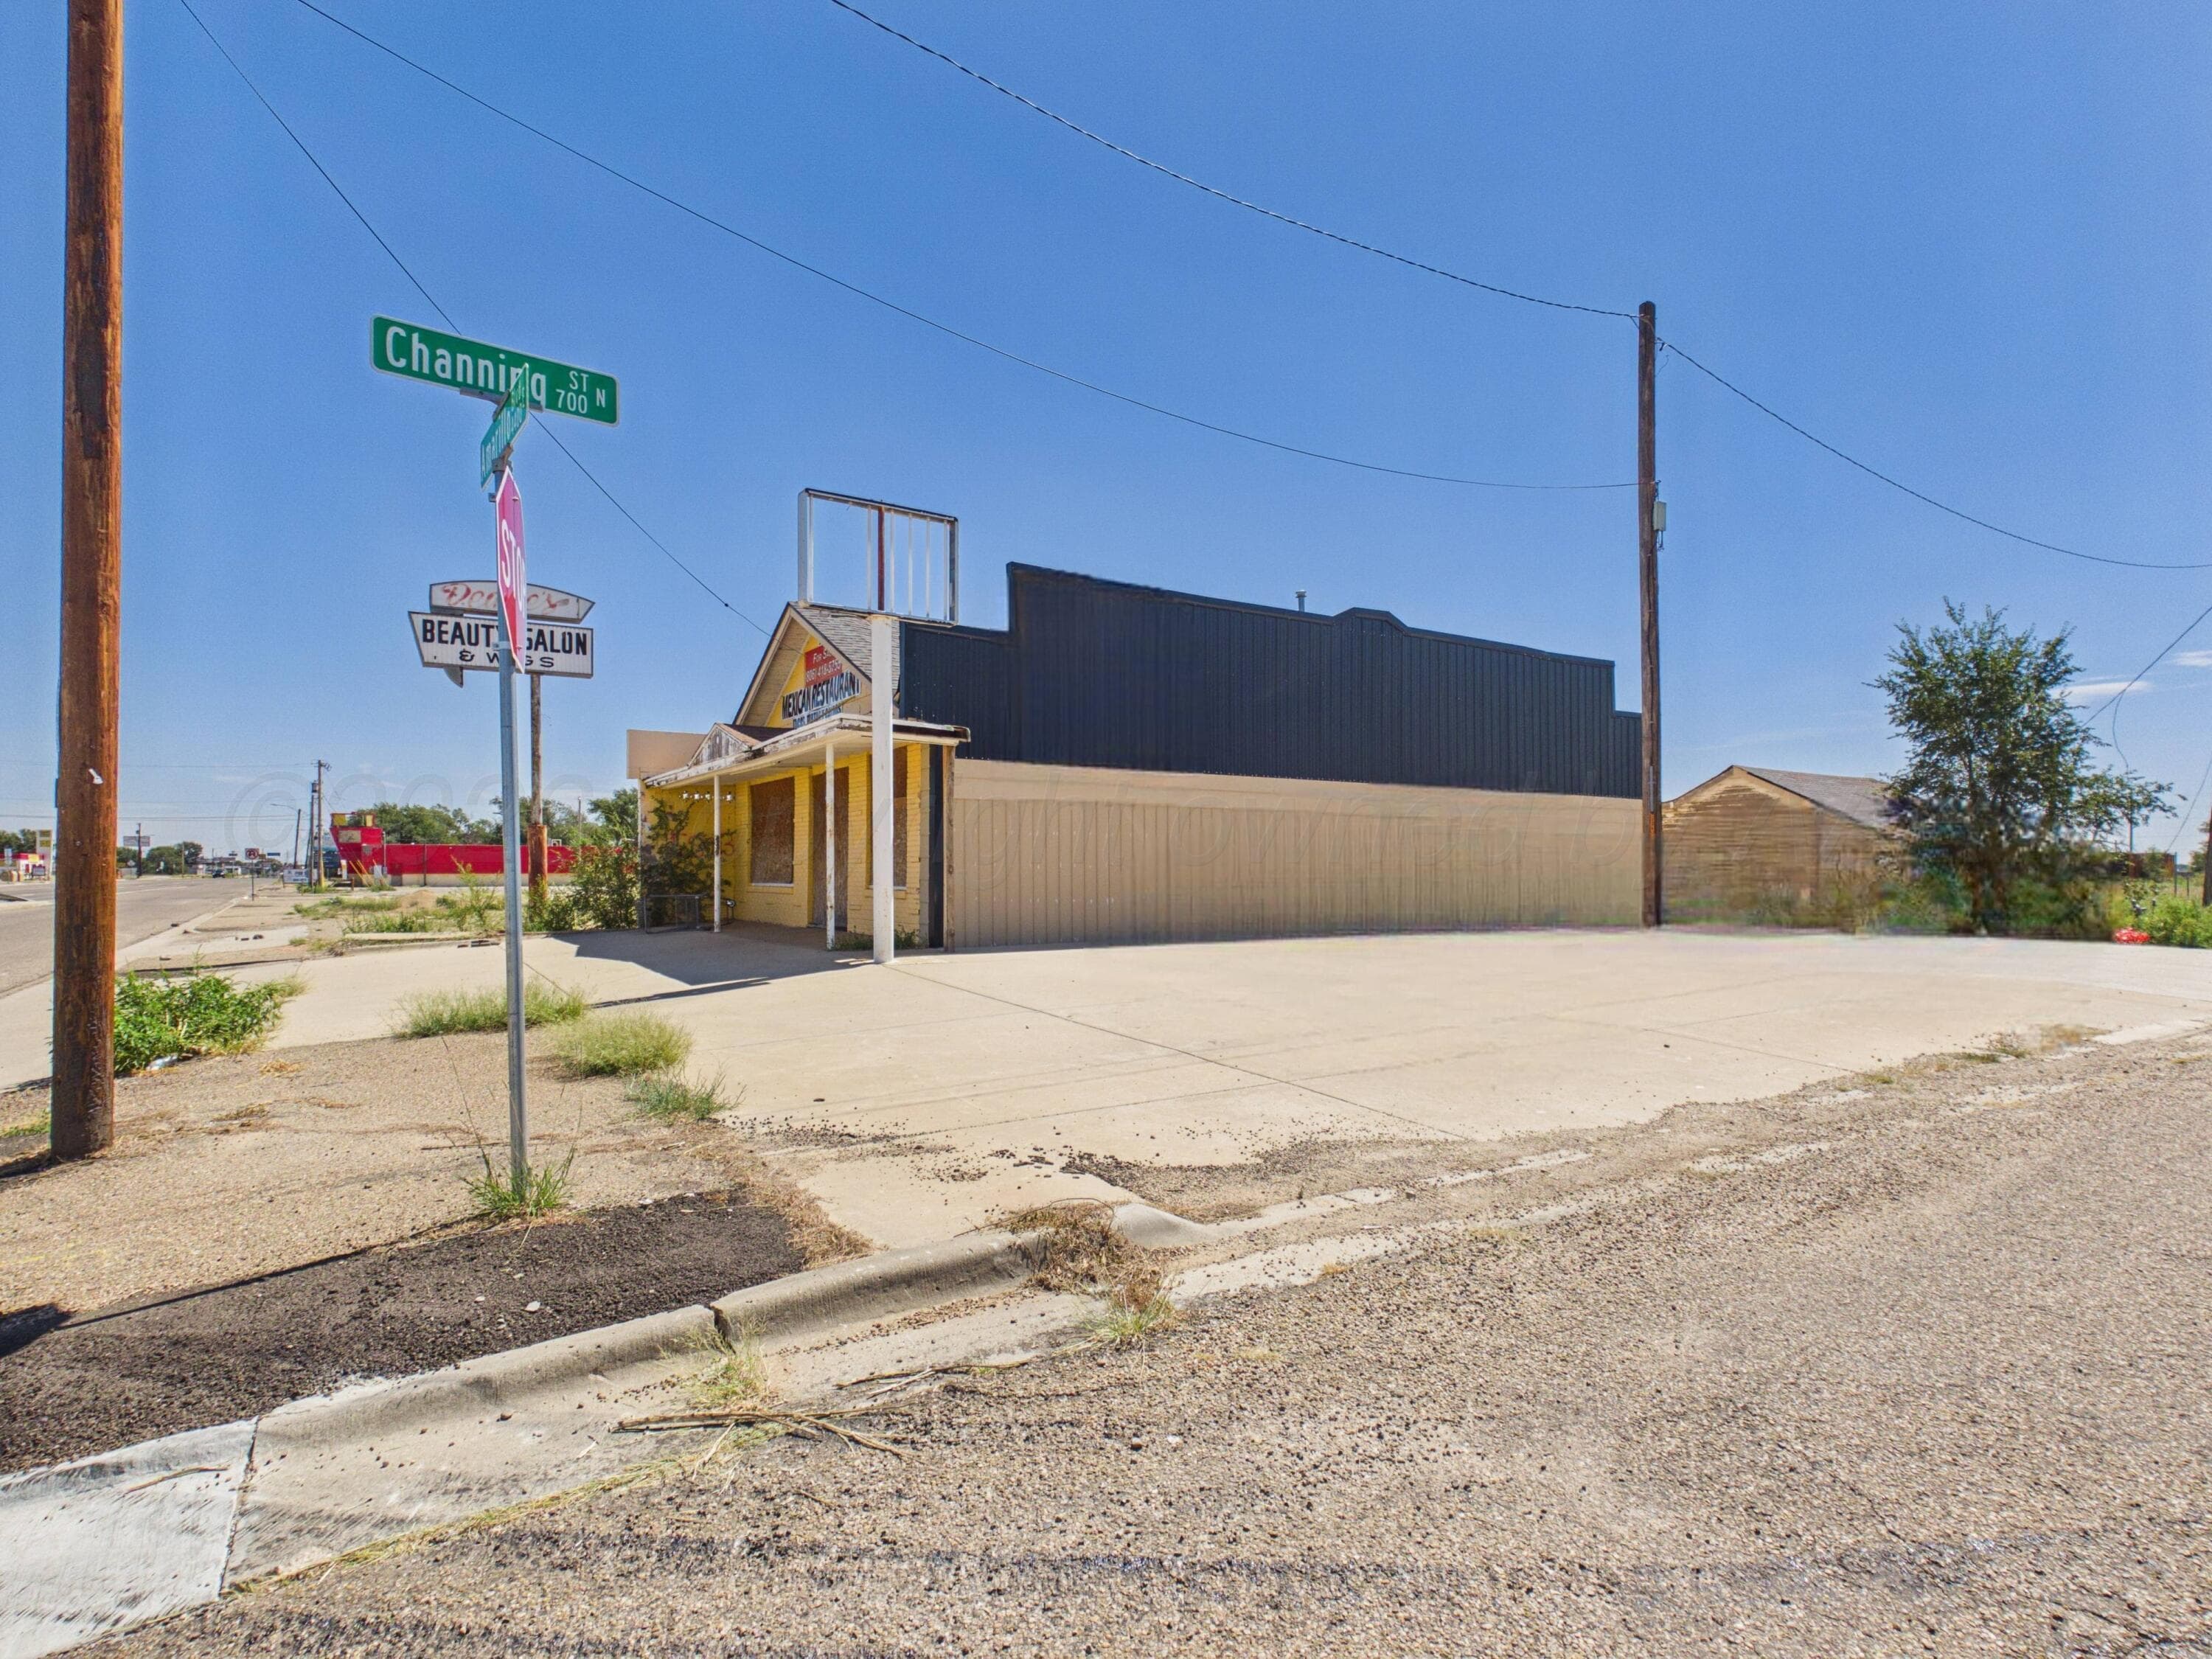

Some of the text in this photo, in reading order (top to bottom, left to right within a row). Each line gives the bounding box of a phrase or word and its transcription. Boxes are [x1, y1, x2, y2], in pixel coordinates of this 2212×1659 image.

[568, 370, 590, 392] ST
[555, 387, 606, 414] 700 N
[501, 518, 526, 619] STOP
[422, 618, 498, 648] BEAUT
[459, 648, 475, 662] &
[782, 686, 812, 720] MEXICAN
